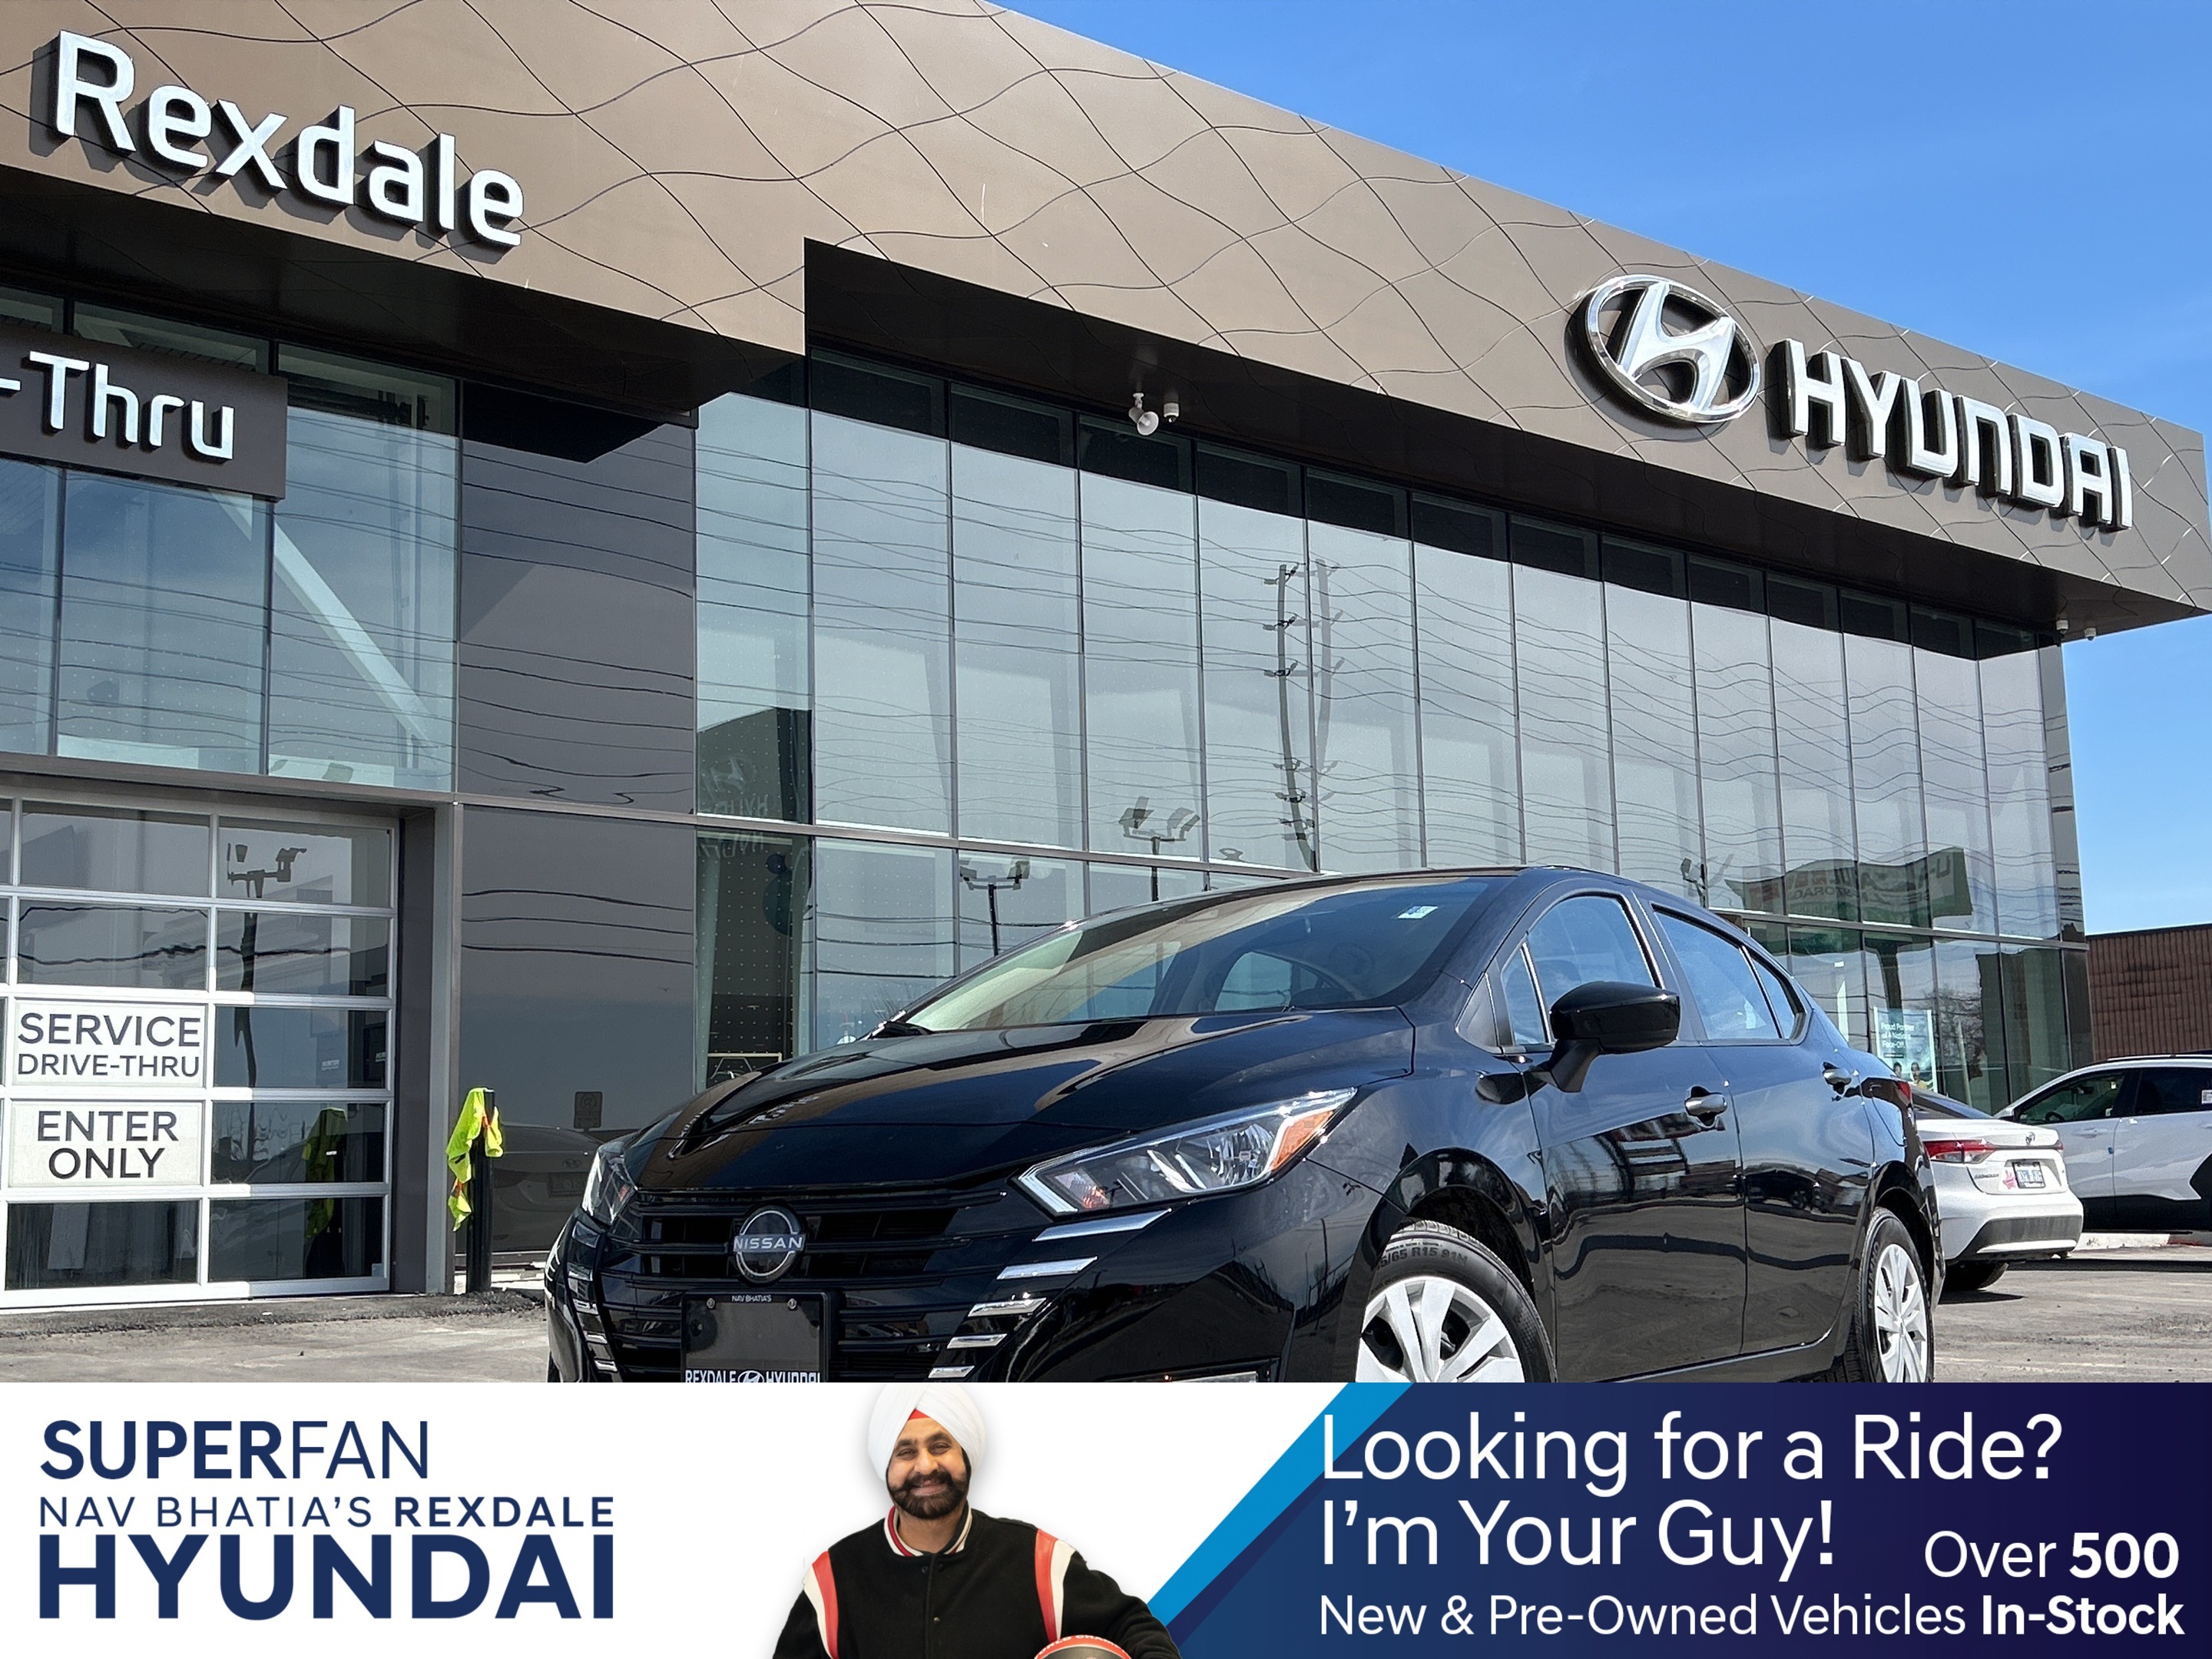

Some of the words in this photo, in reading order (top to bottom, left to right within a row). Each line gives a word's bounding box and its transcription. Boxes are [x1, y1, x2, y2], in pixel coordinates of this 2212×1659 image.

[55, 29, 525, 248] Rexdale
[0, 350, 235, 460] -Thru
[1780, 338, 2133, 531] HYUNDAI
[18, 1012, 200, 1046] SERVICE
[18, 1054, 200, 1077] DRIVE-THRU
[37, 1111, 179, 1141] ENTER
[48, 1147, 165, 1179] ONLY
[733, 1237, 803, 1250] NISSAN
[1378, 1249, 1408, 1268] 5/65
[1411, 1247, 1439, 1257] R15
